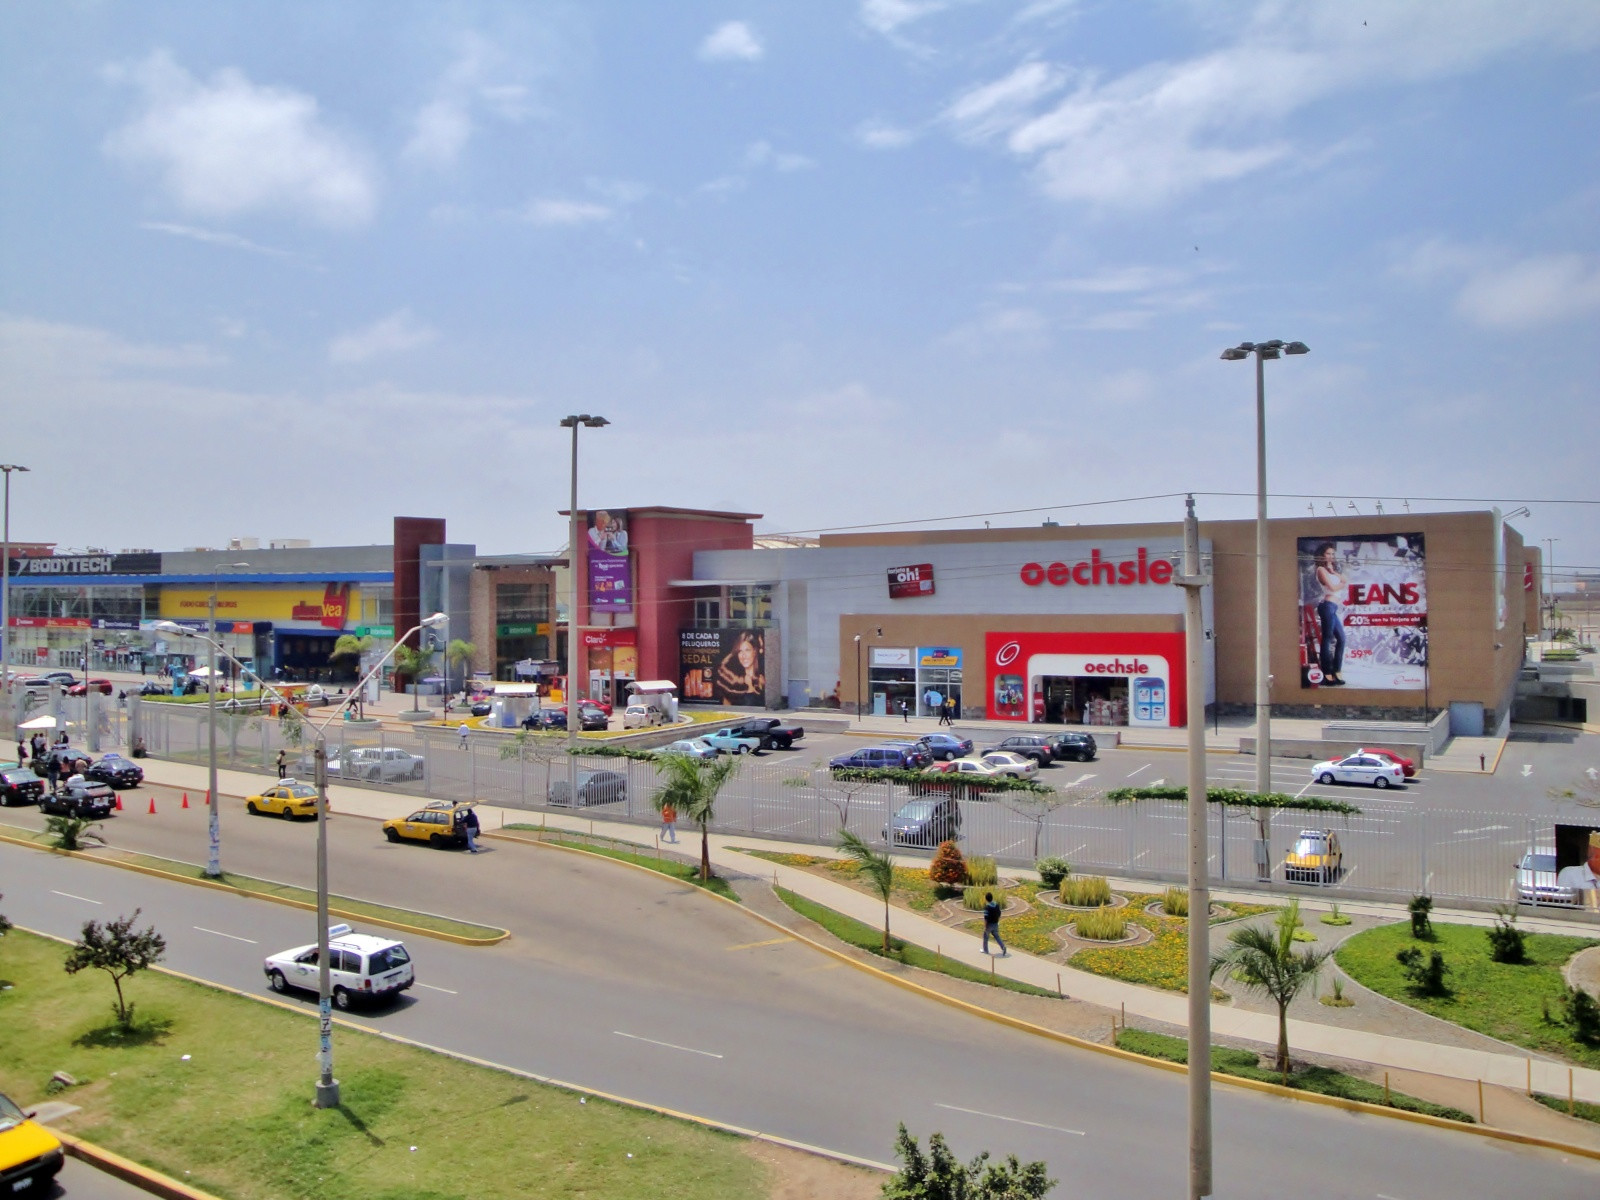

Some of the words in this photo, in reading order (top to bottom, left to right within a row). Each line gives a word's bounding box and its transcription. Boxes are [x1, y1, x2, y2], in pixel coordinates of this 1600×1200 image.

[30, 557, 112, 573] BODYTECH
[1020, 547, 1173, 586] oechsle
[897, 567, 920, 582] oh!
[1342, 583, 1420, 606] JEANS
[321, 603, 342, 617] Vea
[585, 635, 604, 644] Claro
[695, 632, 712, 640] CADA
[682, 654, 713, 664] SEDAL
[1084, 658, 1149, 674] oechsle
